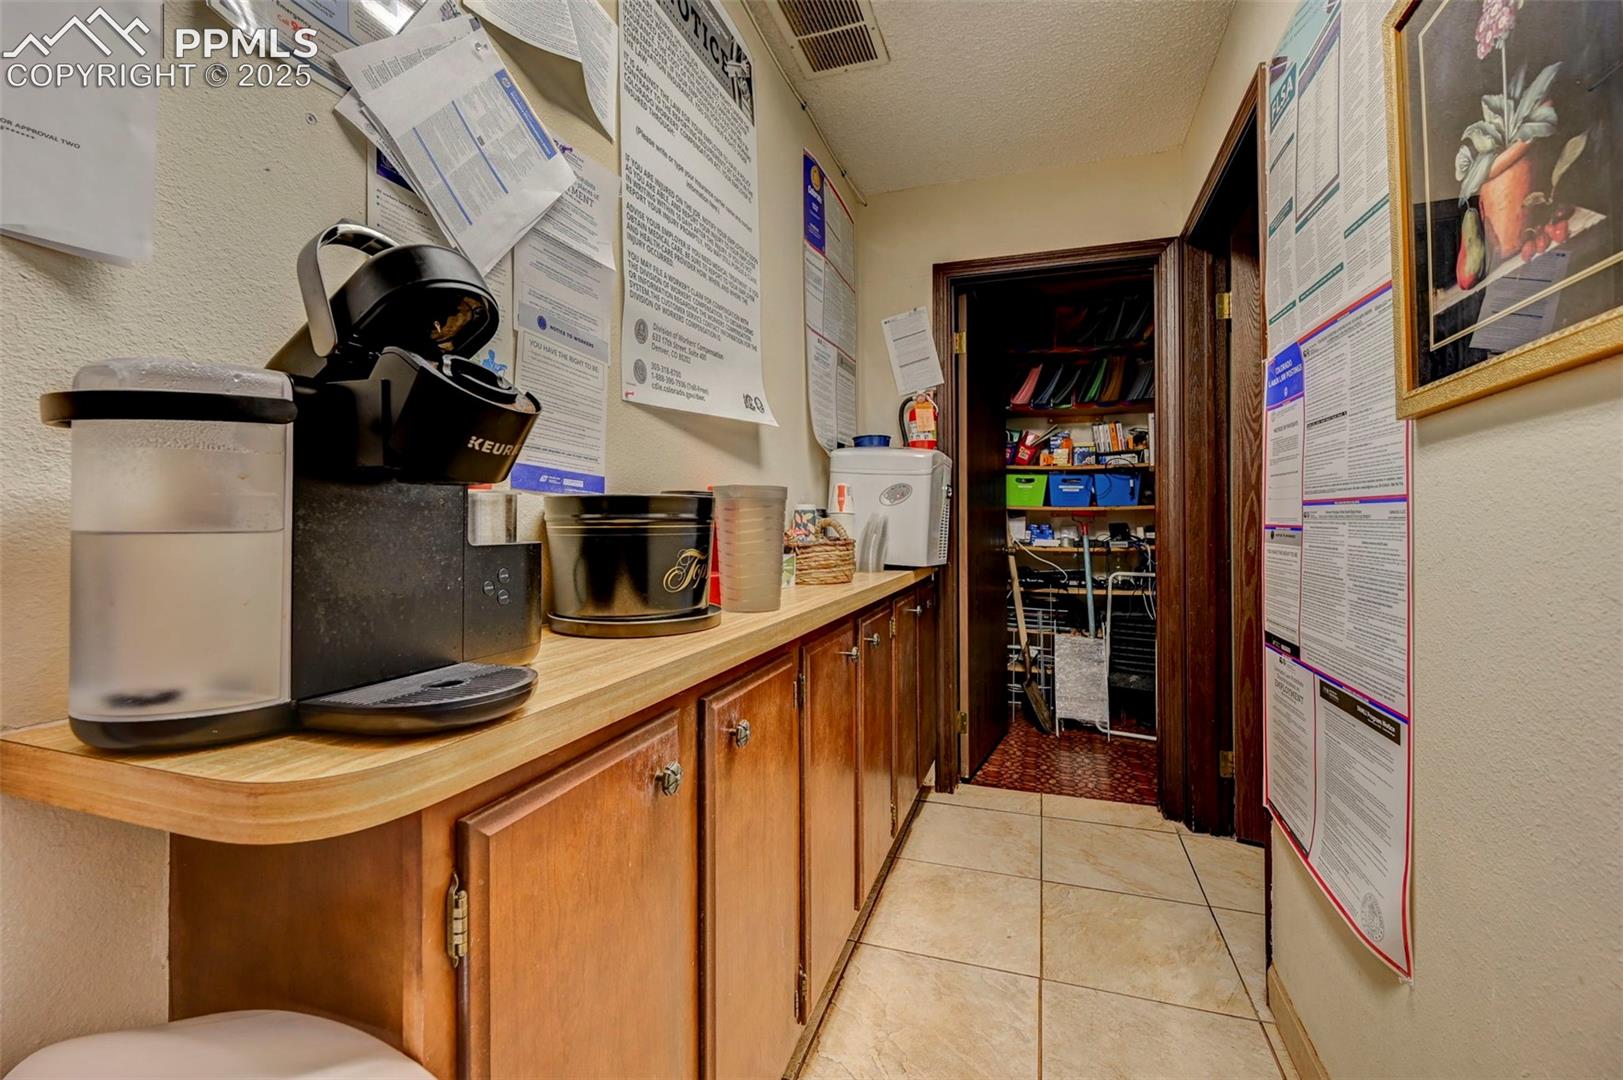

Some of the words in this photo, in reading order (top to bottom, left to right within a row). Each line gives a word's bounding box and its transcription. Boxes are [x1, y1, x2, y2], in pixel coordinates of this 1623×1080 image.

[668, 0, 730, 78] OTICE
[1271, 74, 1294, 122] FLSA
[14, 123, 59, 142] APPROVAL
[60, 138, 81, 149] TWO
[626, 183, 645, 206] REPORT
[647, 199, 661, 217] YOUR
[662, 210, 678, 229] INJURY
[632, 178, 655, 203] WRITING
[657, 197, 674, 217] WITHIN
[626, 201, 644, 222] ADVISE
[645, 215, 660, 232] YOUR
[661, 226, 686, 250] EMPLOYER
[626, 211, 646, 233] OBTAIN
[648, 225, 669, 247] MEDICAL
[626, 231, 645, 251] INJURY
[639, 266, 661, 285] DIVISION
[653, 264, 662, 277] FILE
[629, 289, 653, 309] DIVISION
[638, 274, 673, 300] INFORMATION
[674, 294, 698, 314] REGARDING
[661, 296, 685, 315] CUSTOMER
[653, 322, 672, 338] Division
[528, 338, 543, 350] YOU
[542, 344, 558, 357] HAVE
[558, 350, 569, 361] THE
